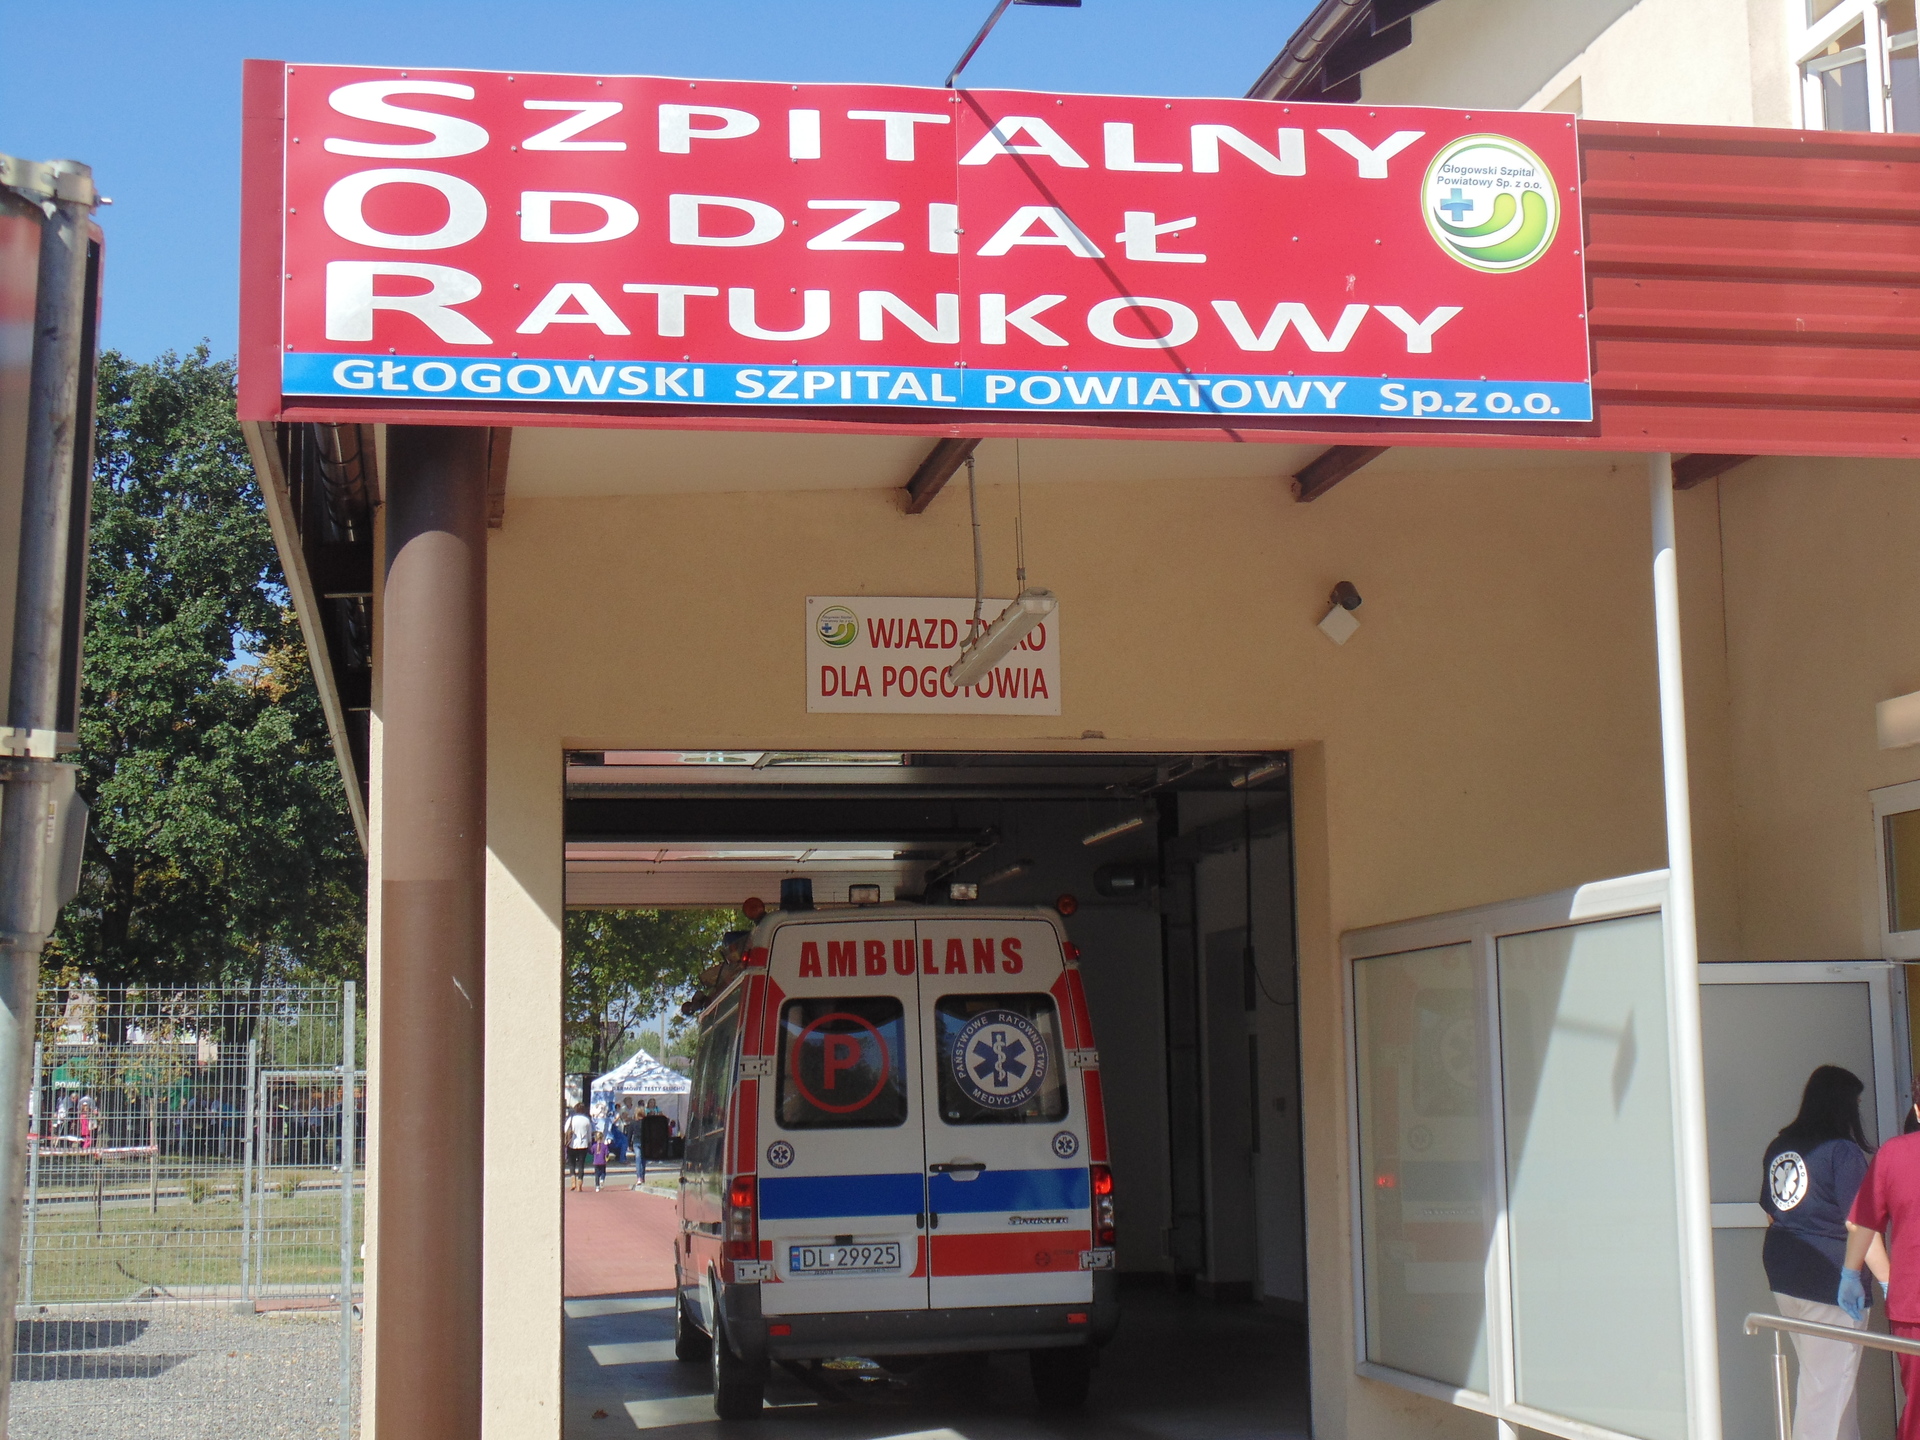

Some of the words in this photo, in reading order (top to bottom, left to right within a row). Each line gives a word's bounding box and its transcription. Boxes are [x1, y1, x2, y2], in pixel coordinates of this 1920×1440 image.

[323, 79, 1426, 179] SZPITALNY
[1436, 175, 1493, 189] Powiatowy
[1496, 178, 1512, 189] Sp.
[1524, 182, 1542, 190] o.o.
[1442, 164, 1498, 176] Głogowski
[1500, 166, 1535, 178] Szpital
[323, 167, 1207, 263] ODDZIAŁ
[324, 260, 1464, 355] RATUNKOWY
[332, 359, 704, 397] GŁOGOWSKI
[733, 369, 957, 403] SZPITAL
[985, 374, 1347, 411] POWIATOWY
[867, 618, 959, 649] WJAZD
[821, 665, 872, 697] DLA
[799, 937, 1023, 978] AMBULANS
[823, 1033, 863, 1090] P
[954, 1016, 988, 1079] PAŃSTWOWE
[998, 1013, 1045, 1078] RATOWNICTWO
[972, 1086, 1032, 1105] MEDYCZNE
[803, 1248, 830, 1268] DL
[837, 1246, 896, 1267] 29925
